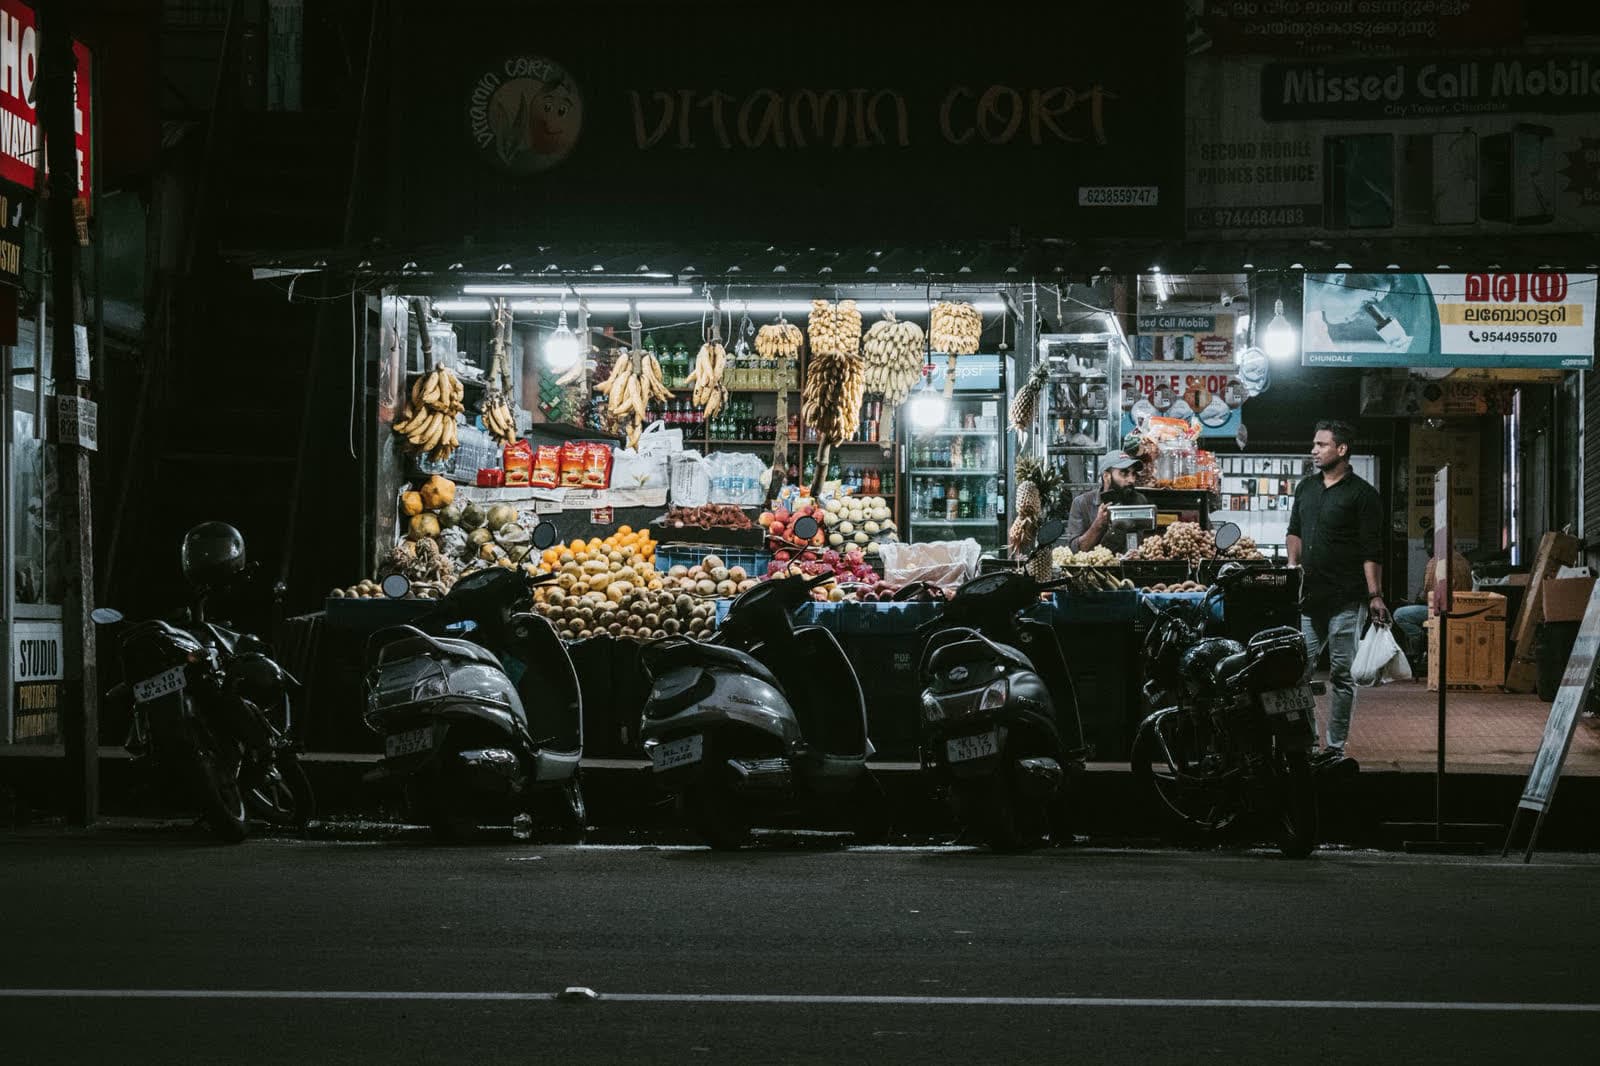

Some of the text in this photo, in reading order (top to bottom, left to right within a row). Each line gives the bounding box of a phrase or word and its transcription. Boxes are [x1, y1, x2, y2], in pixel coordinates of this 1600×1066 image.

[1283, 66, 1404, 104] Missed
[1417, 64, 1478, 98] Call
[1201, 141, 1312, 160] SECOND MOBILE
[1198, 165, 1314, 184] PHONES SERVICE
[1159, 317, 1176, 328] Call
[1178, 317, 1209, 328] Mobile
[1481, 331, 1557, 343] 9544955070
[20, 639, 57, 677] STUDIO
